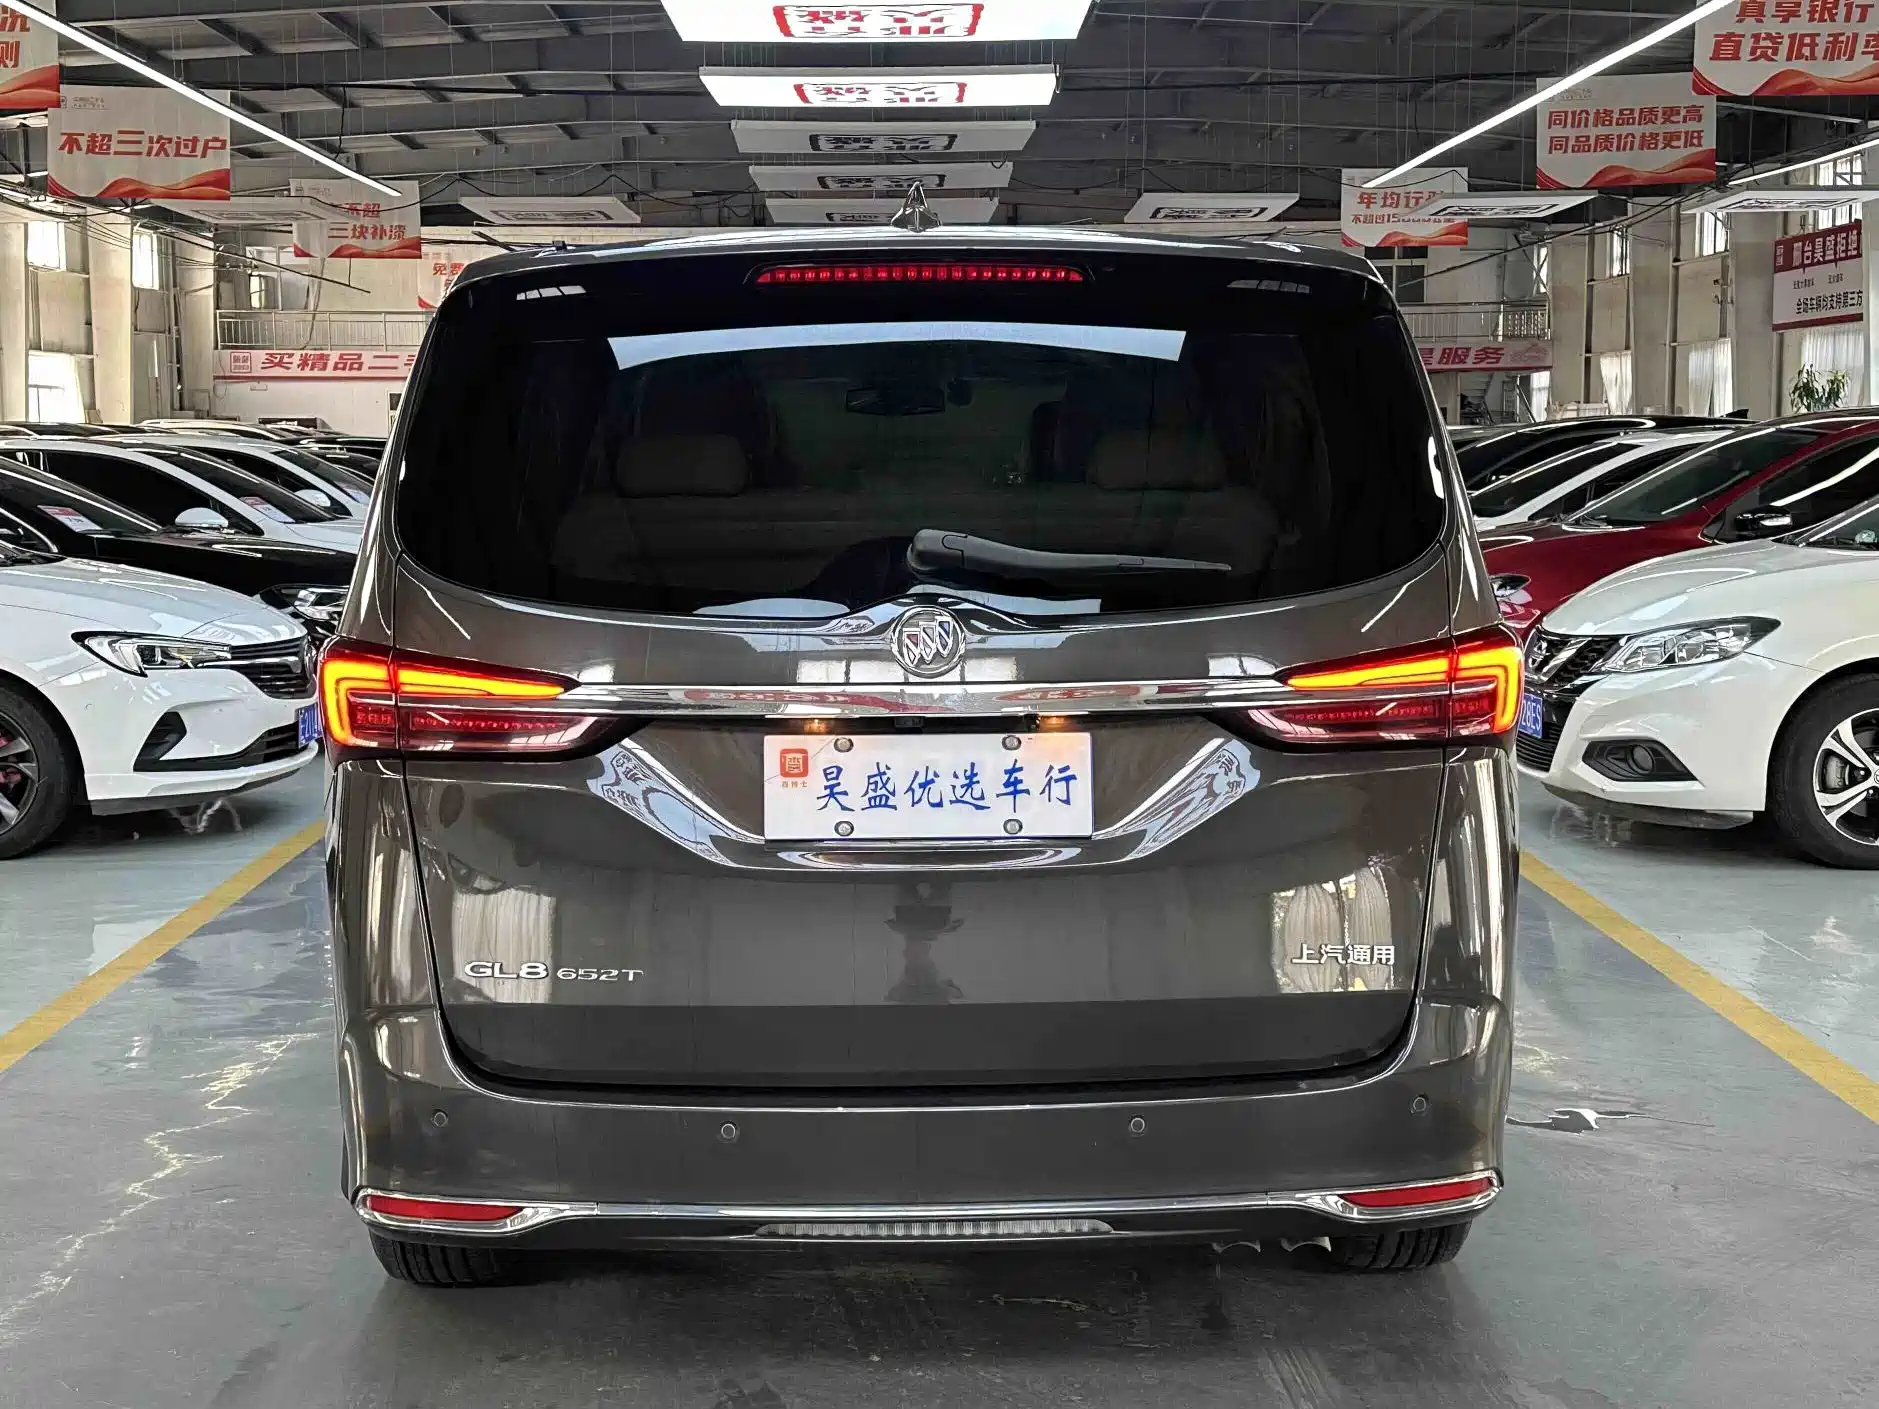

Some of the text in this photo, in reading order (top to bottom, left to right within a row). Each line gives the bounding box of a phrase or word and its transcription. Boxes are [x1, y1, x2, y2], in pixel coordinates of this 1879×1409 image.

[1547, 104, 1705, 130] 同价格品质更高
[58, 129, 228, 159] 不超三次过户
[1548, 129, 1705, 155] 同品质价格更低
[328, 222, 406, 241] 三块补漆
[816, 759, 1080, 813] 昊盛优选车行
[1291, 943, 1396, 965] 上汽通用
[464, 961, 645, 982] GL8 652T
